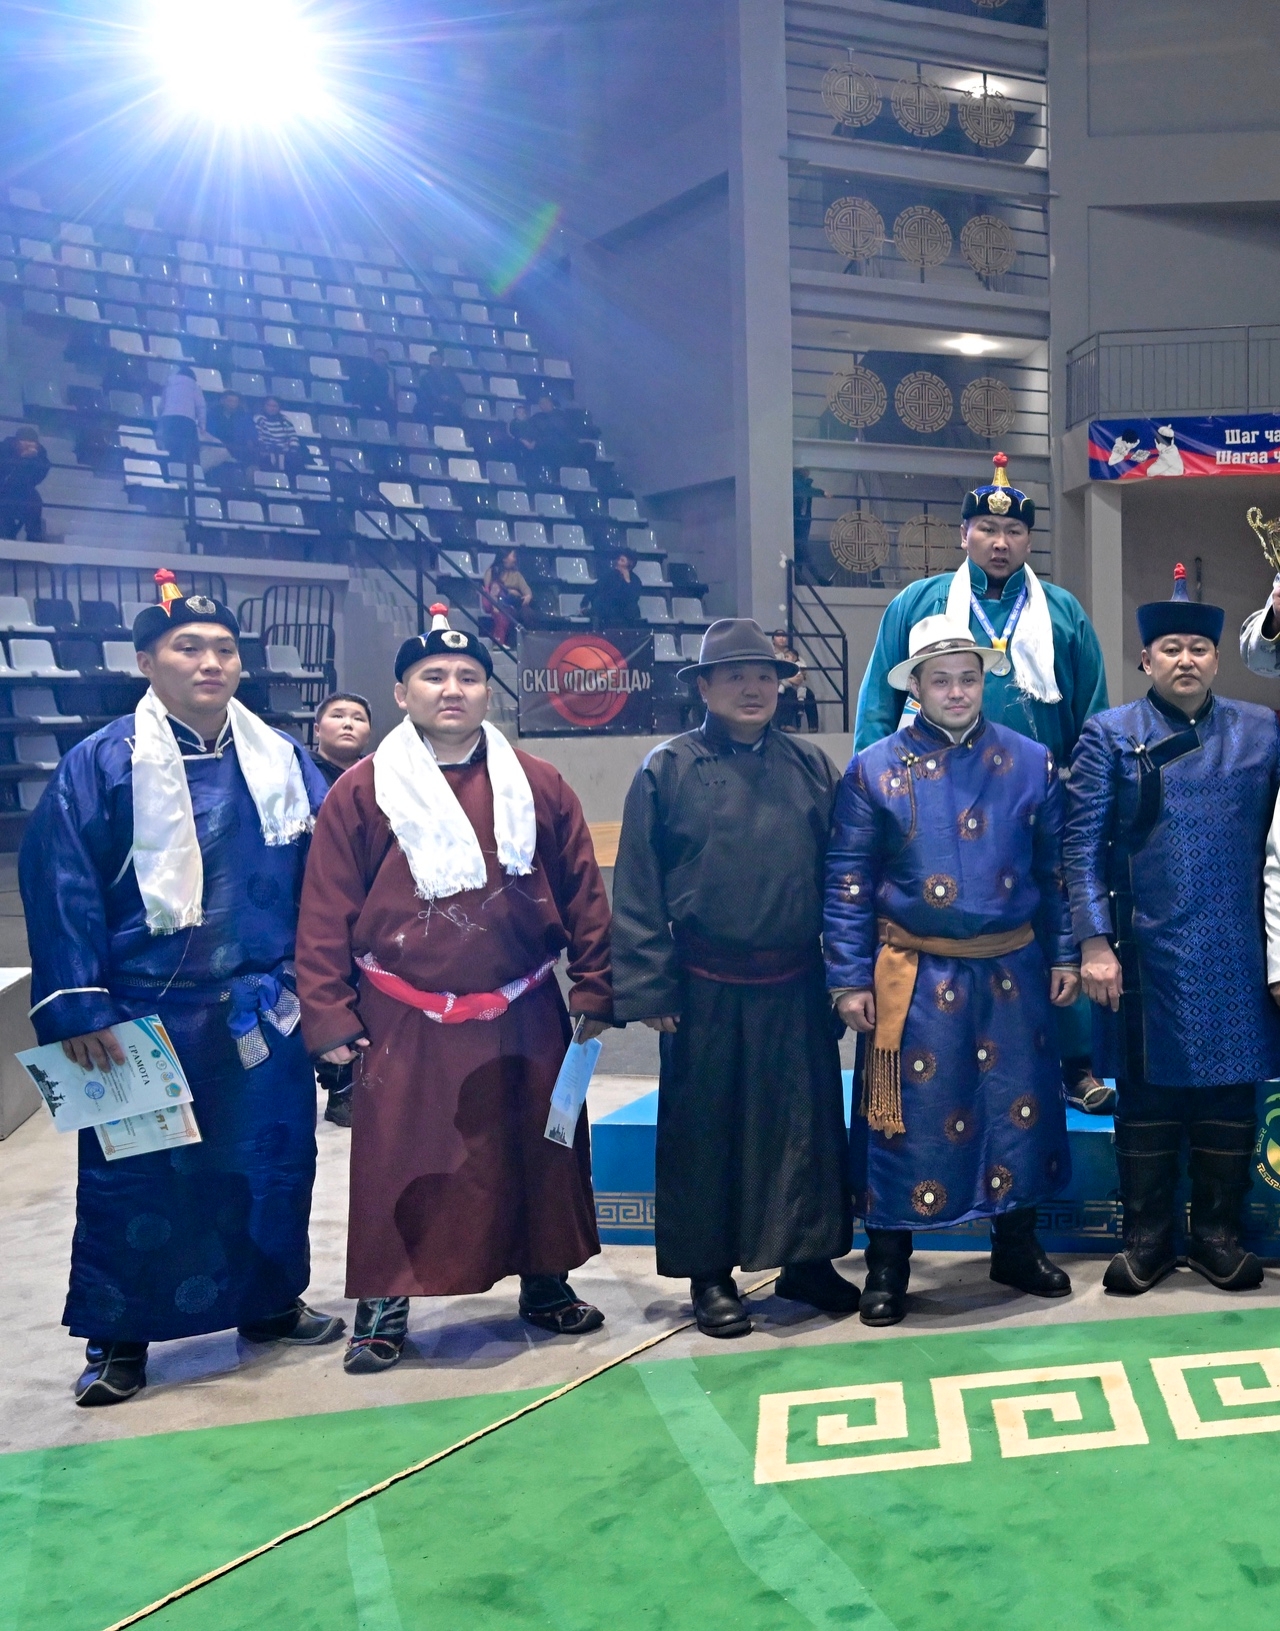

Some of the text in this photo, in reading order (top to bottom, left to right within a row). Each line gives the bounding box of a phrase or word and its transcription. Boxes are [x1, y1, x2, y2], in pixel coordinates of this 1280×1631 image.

[1225, 429, 1259, 445] Шаг
[1215, 450, 1268, 465] Шагаа
[522, 669, 650, 694] СКЦ «ПОБЕДА»
[129, 1044, 151, 1085] ГРАМОТА
